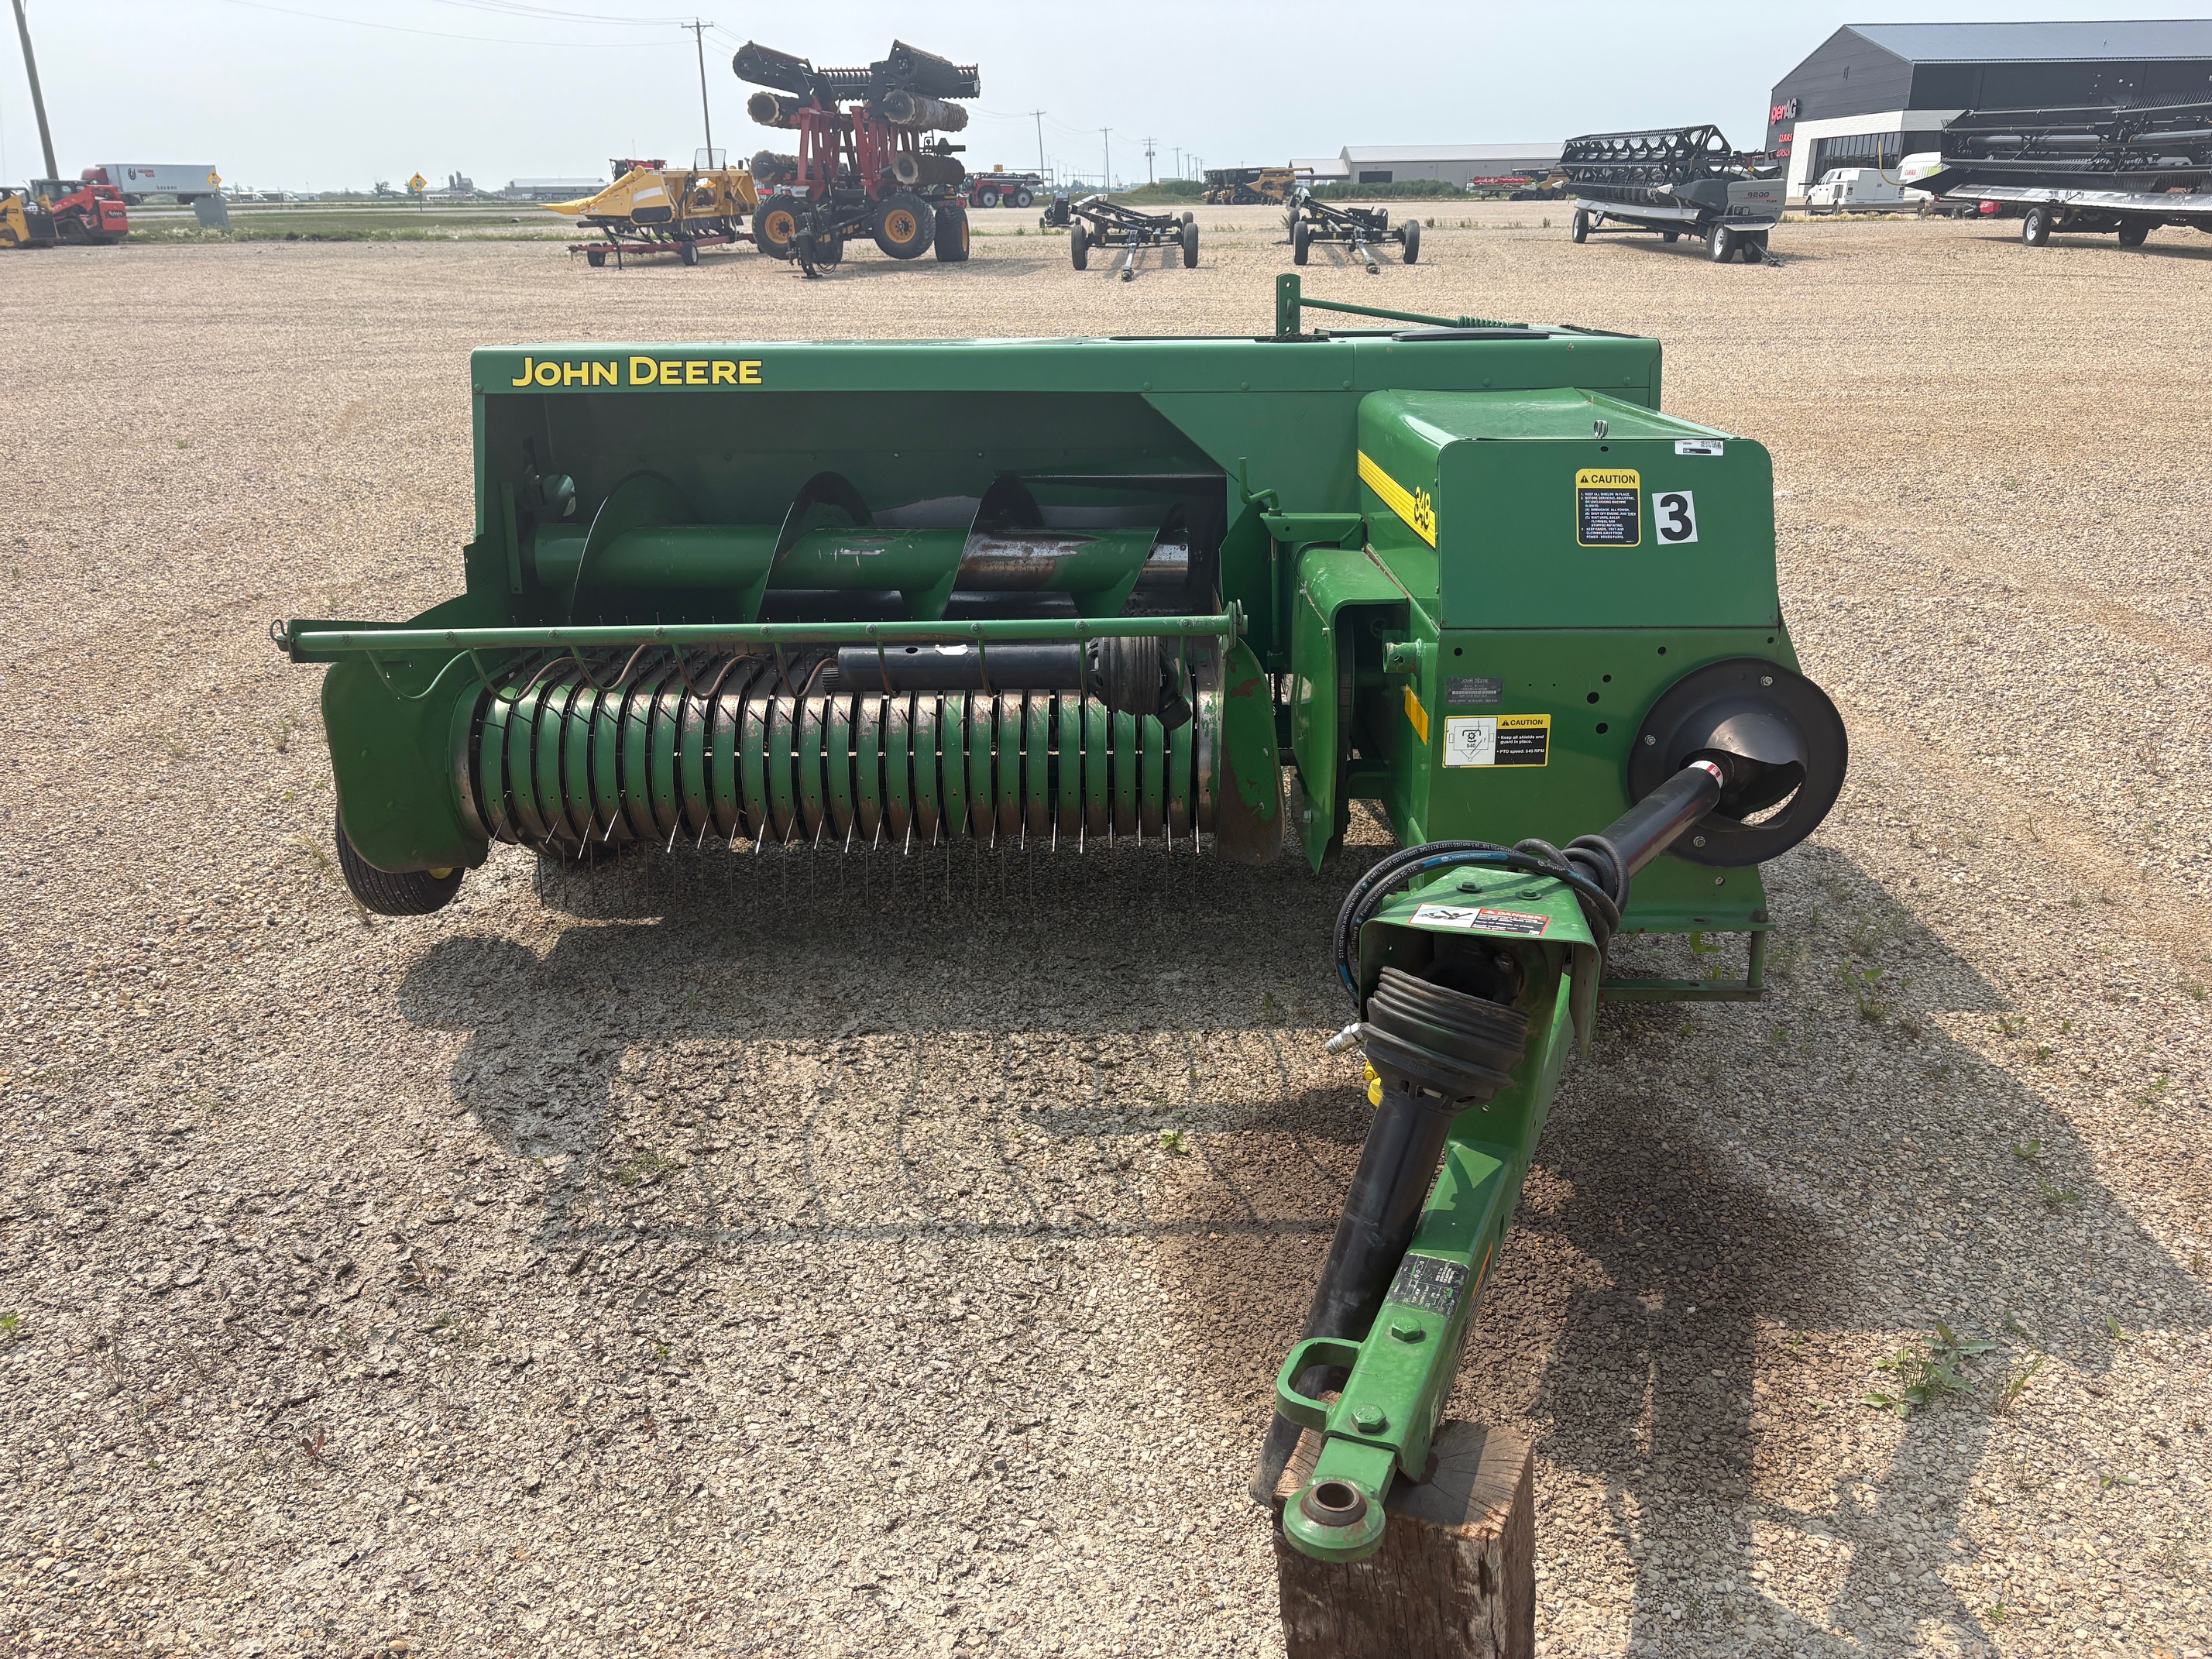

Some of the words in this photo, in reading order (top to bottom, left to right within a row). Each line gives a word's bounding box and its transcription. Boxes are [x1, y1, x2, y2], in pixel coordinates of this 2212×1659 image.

[512, 356, 618, 386] JOHN
[629, 356, 762, 386] DEERE
[1592, 475, 1635, 483] CAUTION
[1414, 486, 1431, 532] 348
[1661, 494, 1692, 541] 3
[1369, 882, 1389, 903] Resistant
